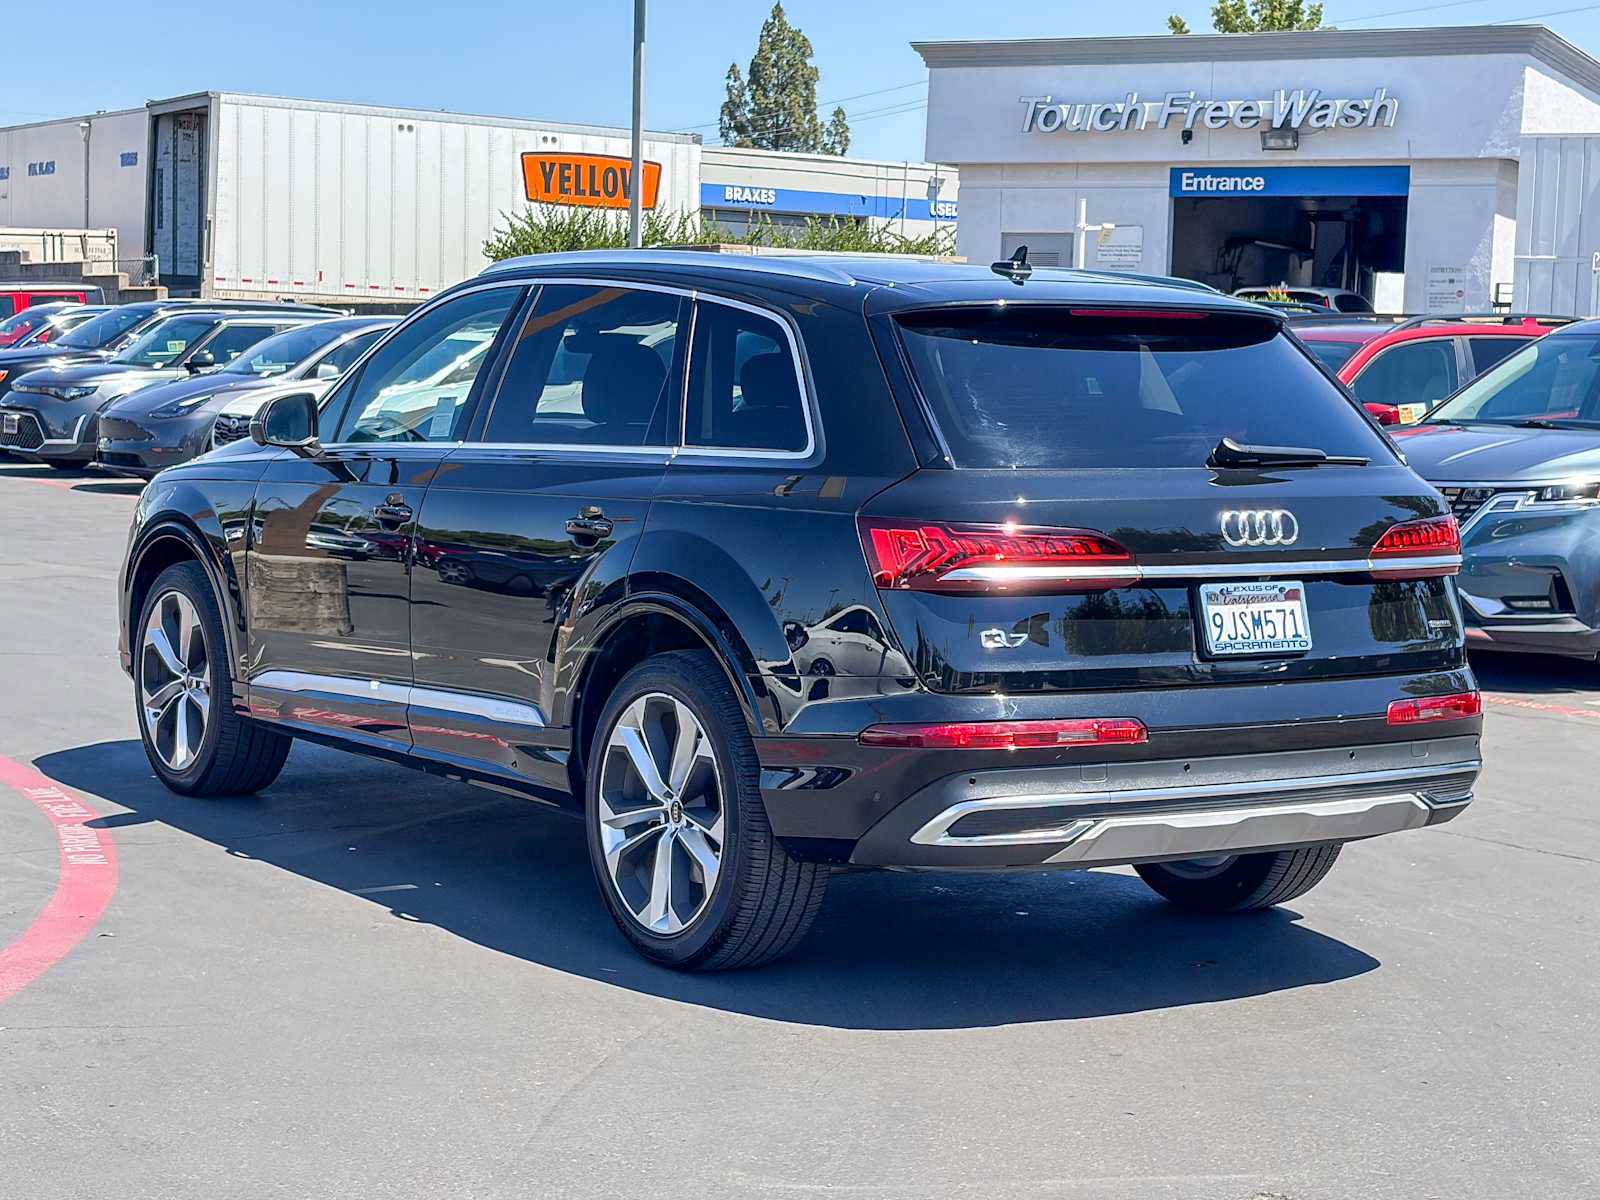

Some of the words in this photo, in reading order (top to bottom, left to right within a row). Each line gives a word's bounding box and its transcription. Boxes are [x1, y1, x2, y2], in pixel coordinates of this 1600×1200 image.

[1020, 92, 1148, 133] Touch
[1157, 91, 1263, 130] Free
[1271, 87, 1399, 130] Wash
[1182, 172, 1265, 191] Entrance
[725, 186, 776, 204] BRAKES
[1226, 586, 1263, 595] LEXUS
[1264, 585, 1278, 593] OF
[1223, 594, 1279, 609] California
[1211, 608, 1303, 641] 9JSM571
[980, 628, 1029, 649] Q7
[1214, 640, 1309, 652] SACRAMENTO
